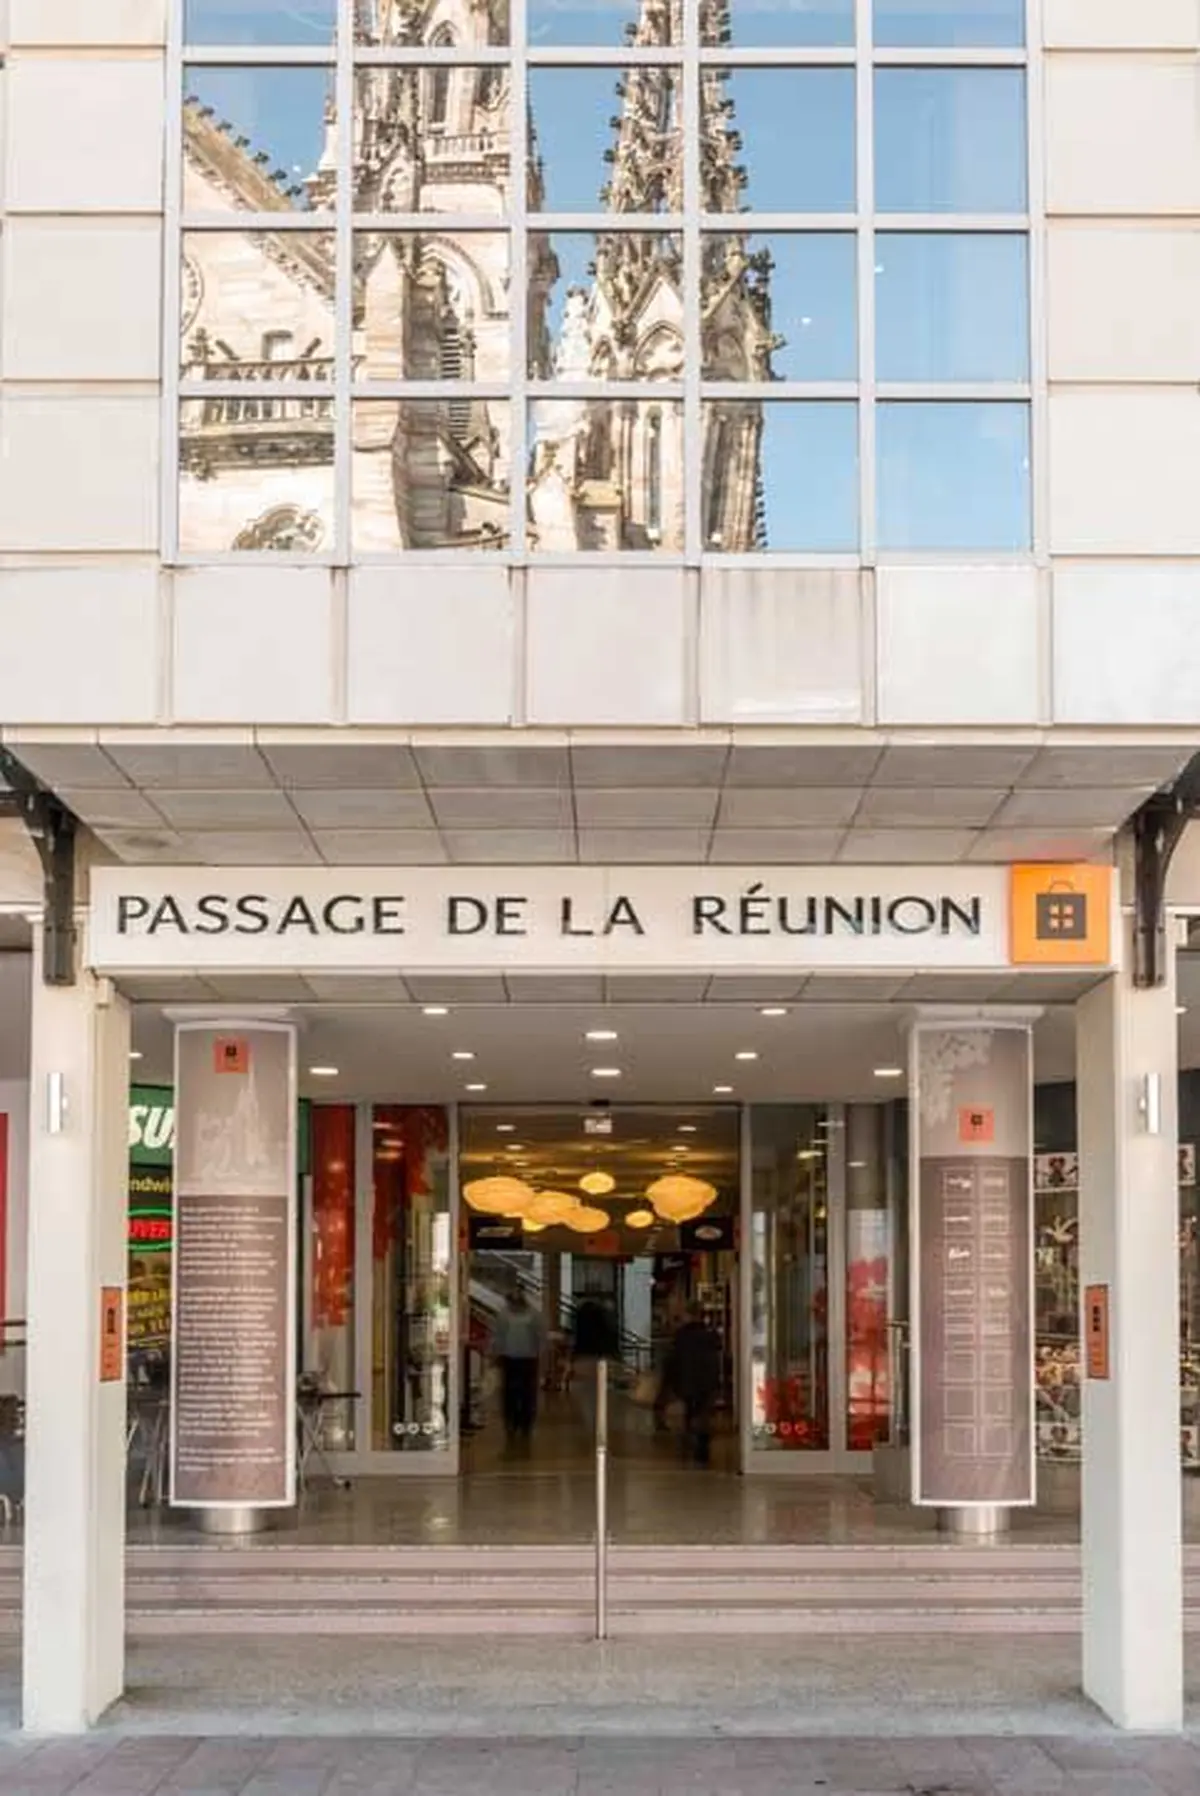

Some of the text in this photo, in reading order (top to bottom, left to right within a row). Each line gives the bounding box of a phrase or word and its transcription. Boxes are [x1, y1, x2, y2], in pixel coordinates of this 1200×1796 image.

[118, 882, 981, 936] PASSAGE DE LA RÉUNION
[129, 1105, 174, 1149] SU
